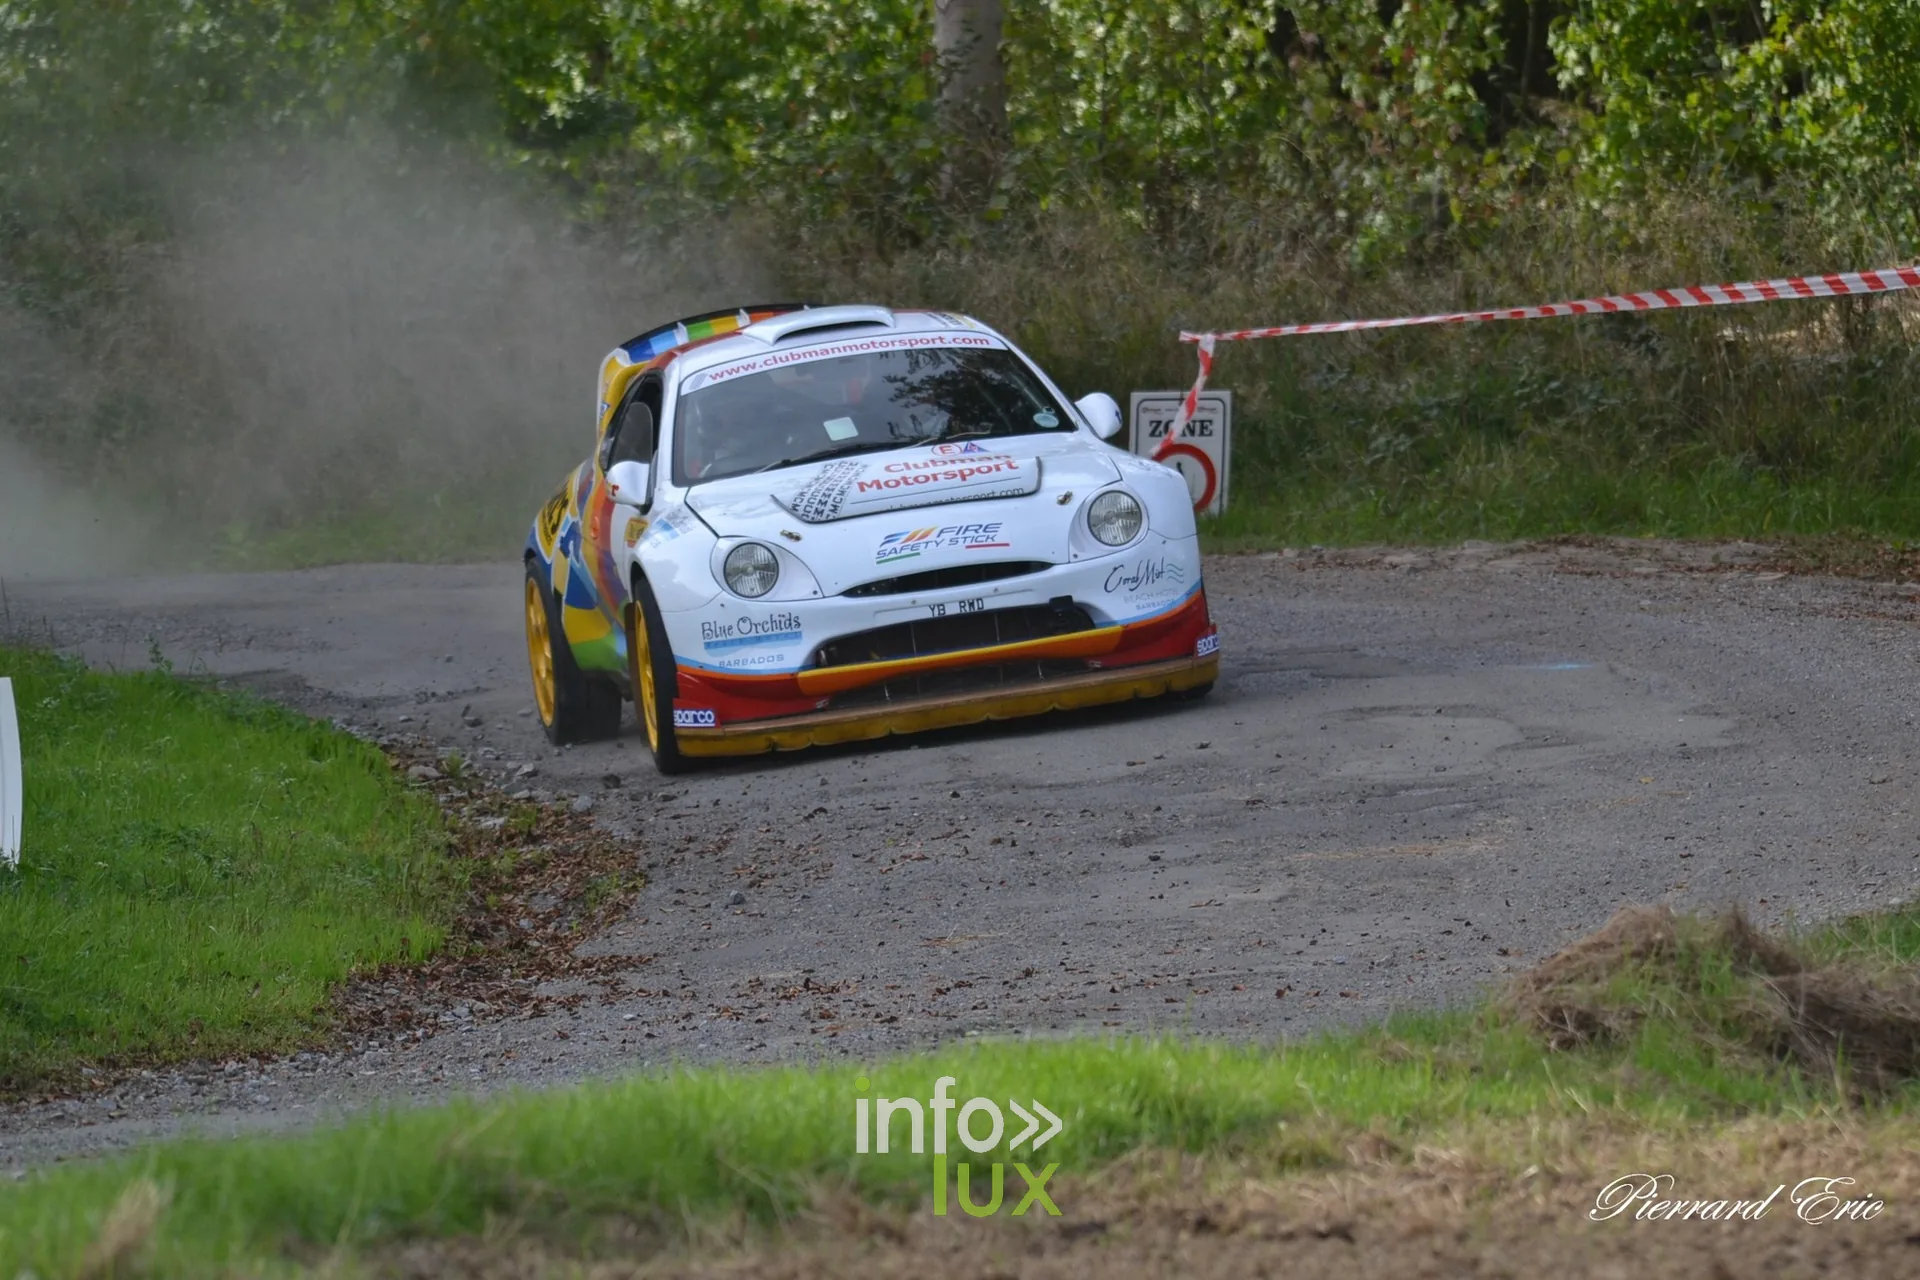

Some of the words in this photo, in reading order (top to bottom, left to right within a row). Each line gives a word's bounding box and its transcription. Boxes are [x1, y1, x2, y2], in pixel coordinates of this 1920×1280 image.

[708, 335, 991, 382] www.clubmanmotorsport.com
[884, 453, 1013, 474] Clubman
[856, 460, 1020, 493] Motorsport
[936, 522, 1003, 539] FIRE
[875, 539, 947, 559] SAFETY
[948, 533, 999, 546] STICK
[929, 604, 946, 617] YB
[959, 598, 984, 613] RWD
[701, 620, 734, 641] Blue
[718, 653, 785, 668] BARBADOS
